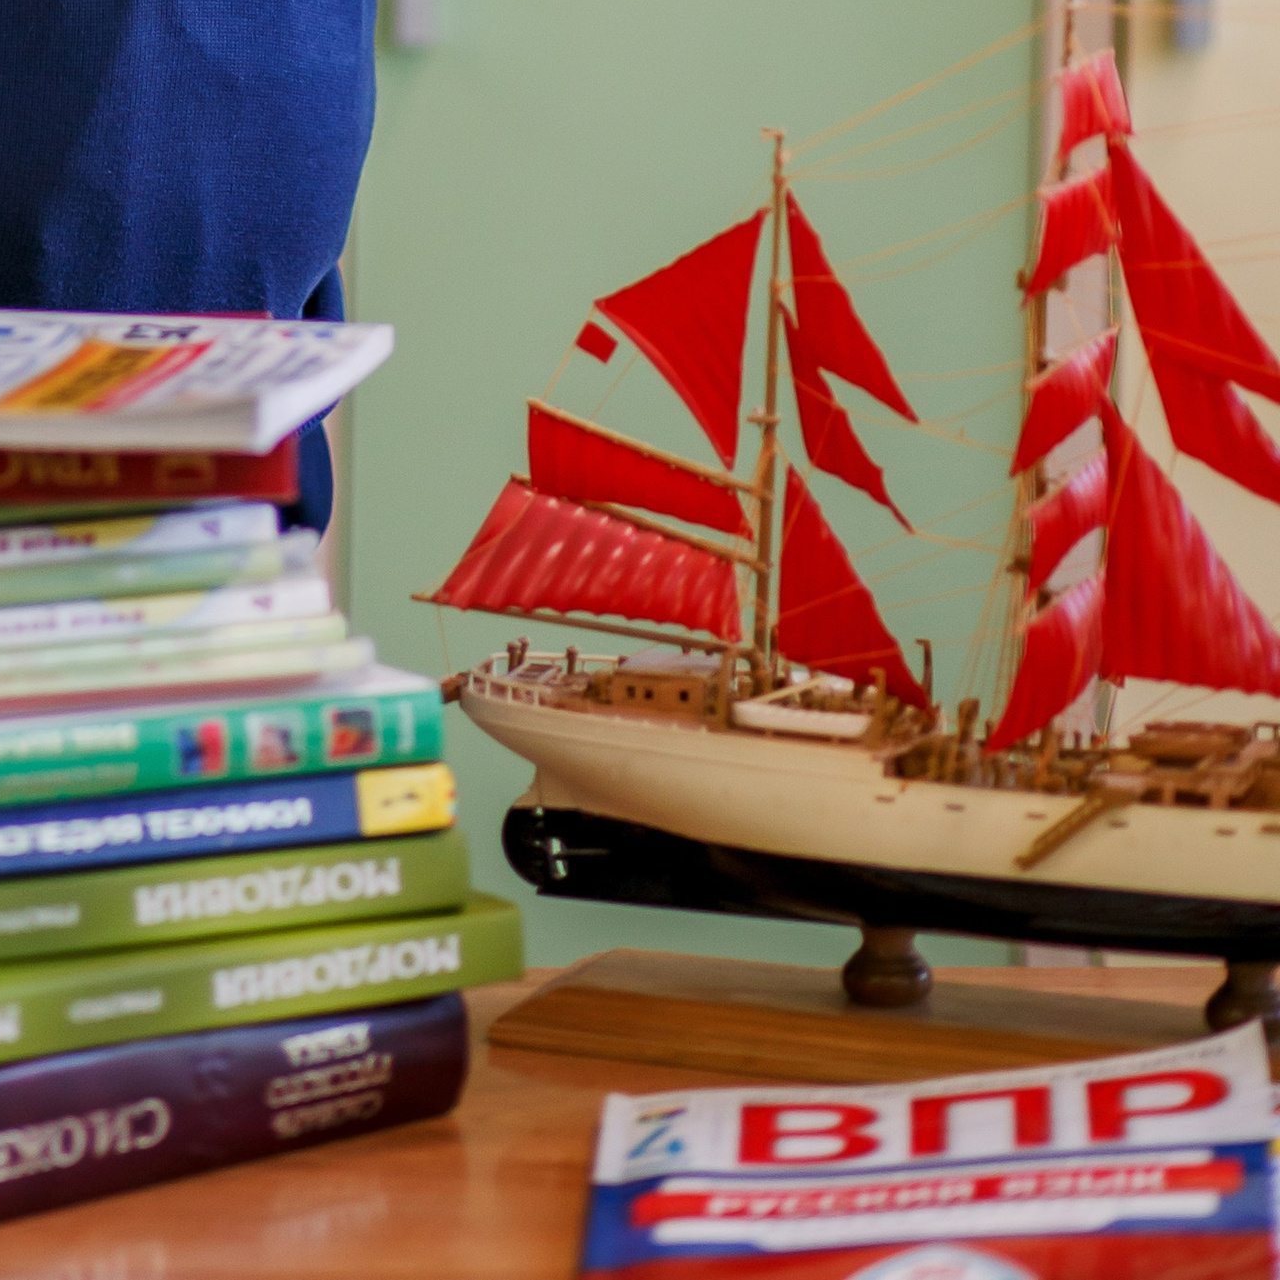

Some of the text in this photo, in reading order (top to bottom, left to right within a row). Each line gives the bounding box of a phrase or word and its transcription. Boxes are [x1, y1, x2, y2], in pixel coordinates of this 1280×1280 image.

[134, 858, 401, 926] МОРДОВИЯ
[213, 935, 461, 1009] МОРДОВИЯ
[737, 1068, 1231, 1167] ВПР
[705, 1167, 1167, 1219] РУССКИЙ ЯЗЫК
